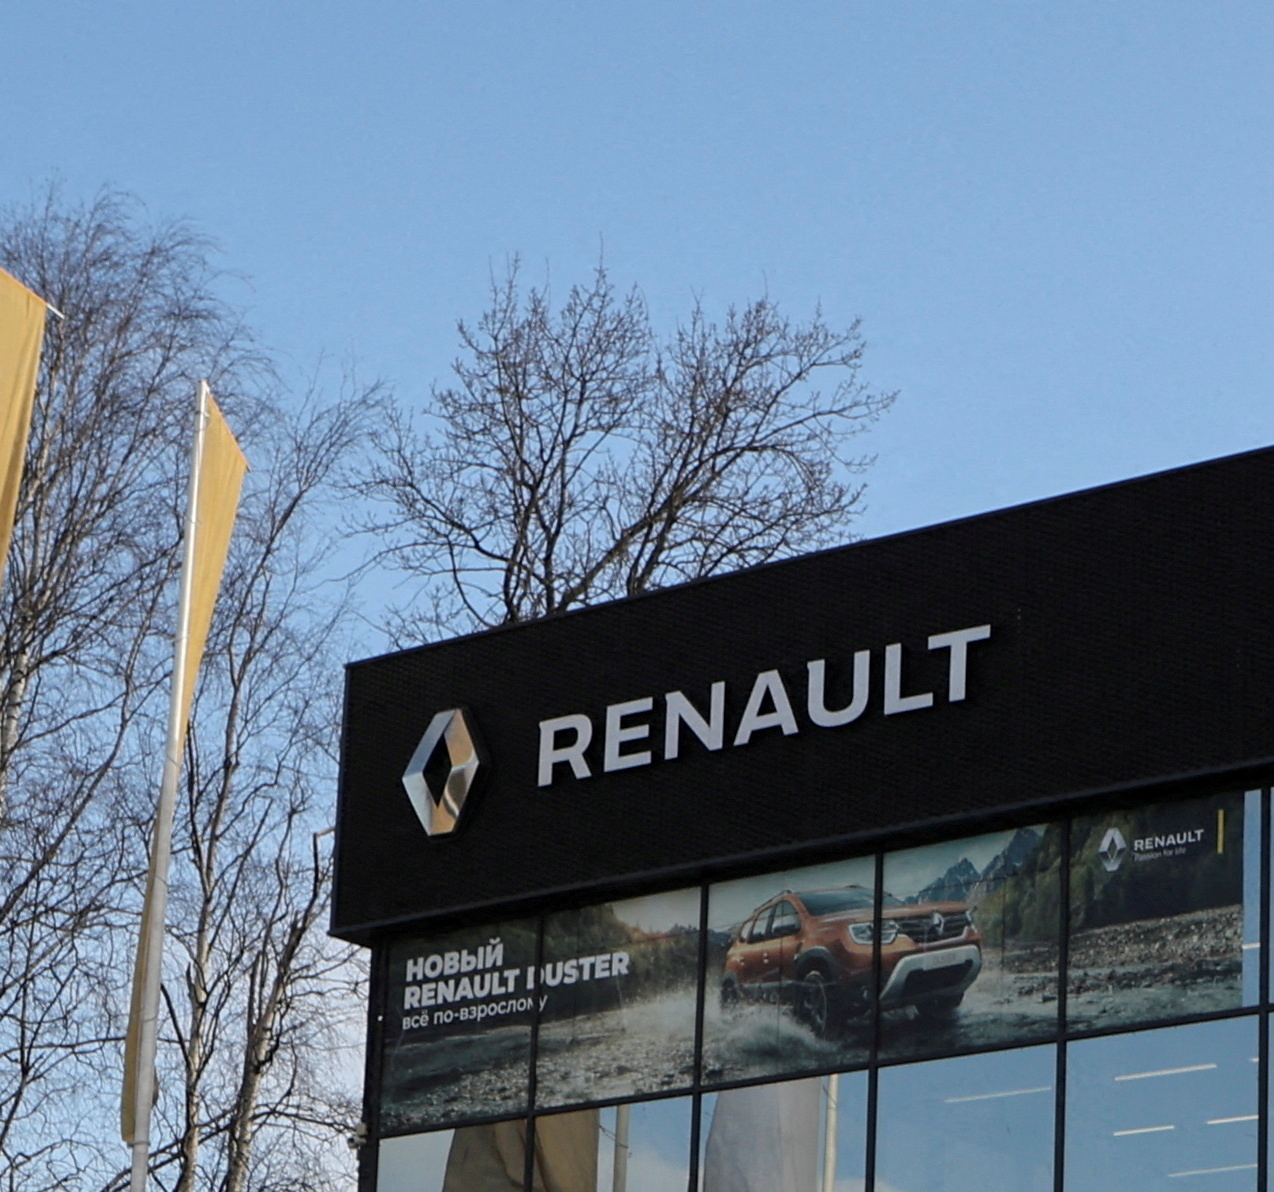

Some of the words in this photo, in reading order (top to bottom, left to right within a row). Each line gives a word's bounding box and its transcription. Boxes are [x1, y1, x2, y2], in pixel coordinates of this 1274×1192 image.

[537, 623, 992, 787] RENAULT
[1134, 829, 1204, 851] RENAULT
[406, 937, 504, 982] НОВЫЙ
[404, 968, 520, 1010] RENAULT
[402, 1009, 429, 1030] всё
